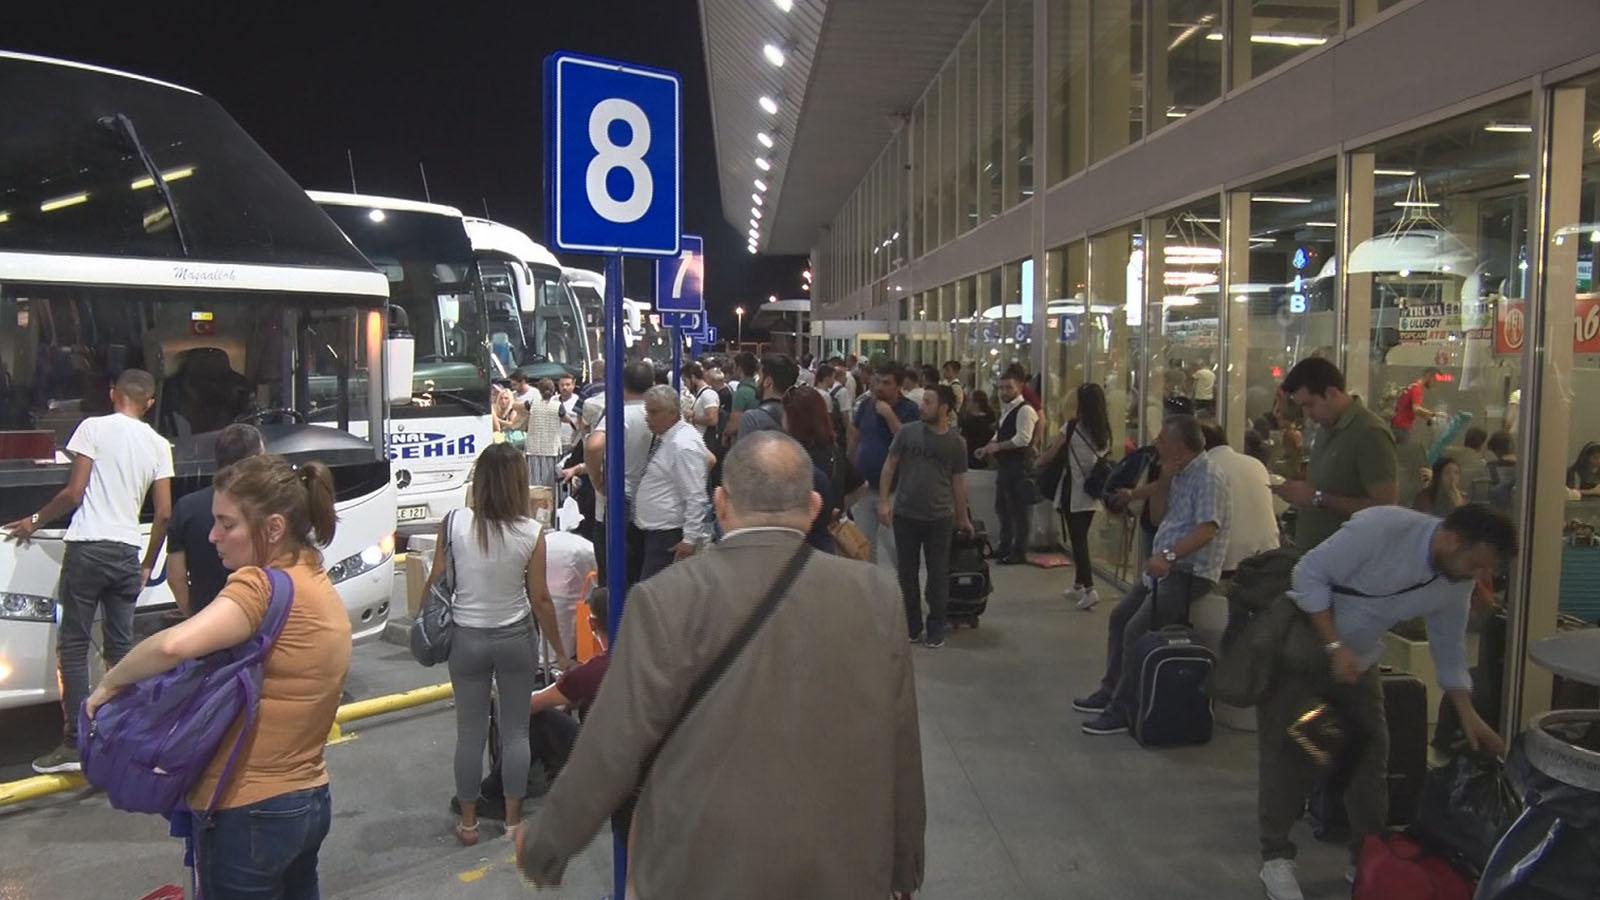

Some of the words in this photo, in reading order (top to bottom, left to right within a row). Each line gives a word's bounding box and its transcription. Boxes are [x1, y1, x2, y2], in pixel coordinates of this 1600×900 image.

[586, 98, 653, 223] 8
[671, 249, 693, 299] 7
[1409, 318, 1441, 329] ULUSOY
[708, 328, 714, 342] 1
[410, 507, 424, 518] 121
